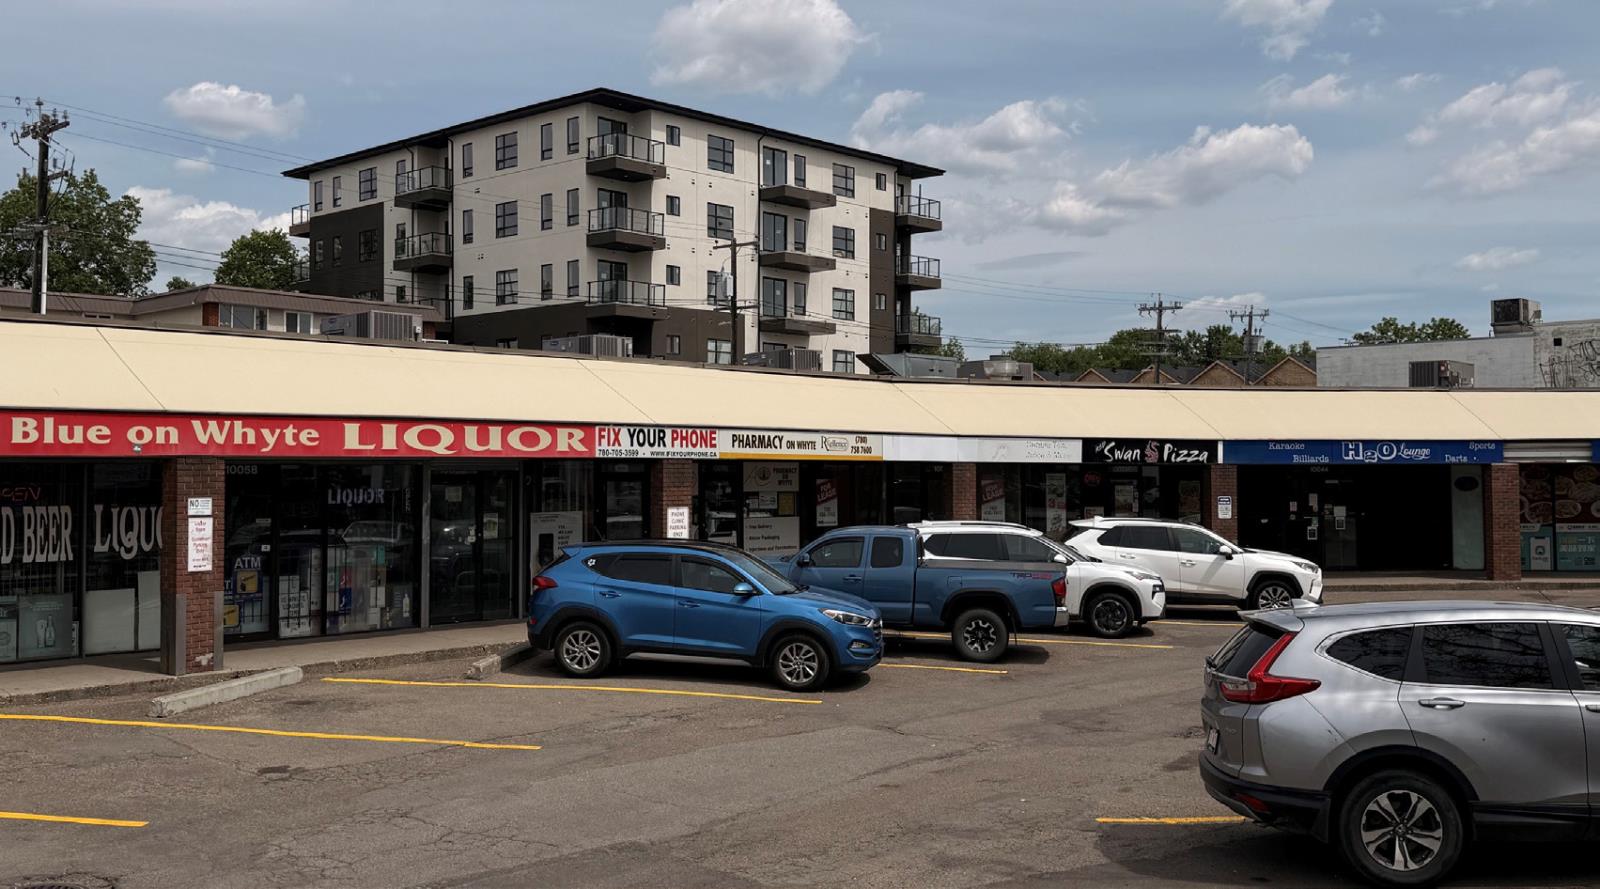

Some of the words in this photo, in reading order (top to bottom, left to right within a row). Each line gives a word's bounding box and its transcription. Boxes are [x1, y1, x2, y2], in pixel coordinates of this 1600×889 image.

[11, 417, 111, 444] Blue
[127, 426, 179, 445] on
[191, 420, 319, 452] Whyte
[343, 423, 589, 454] LIQUOR
[598, 428, 622, 447] FIX
[627, 428, 666, 448] YOUR
[671, 429, 717, 448] PHONE
[732, 434, 784, 449] PHARMACY
[786, 440, 795, 449] ON
[796, 440, 816, 450] WHYTE
[855, 435, 868, 445] (780)
[1104, 441, 1141, 462] Swan
[1164, 443, 1208, 464] Pizza
[1269, 442, 1305, 450] Karaoke
[1398, 442, 1431, 460] Lounge
[1469, 442, 1496, 451] Sports
[598, 449, 639, 457] 780-705-3599
[1293, 454, 1329, 463] Billiards
[1445, 454, 1468, 463] Darts
[327, 488, 385, 506] LIQUOR
[190, 500, 200, 508] NO
[22, 505, 74, 563] BEER
[234, 556, 262, 569] ATM
